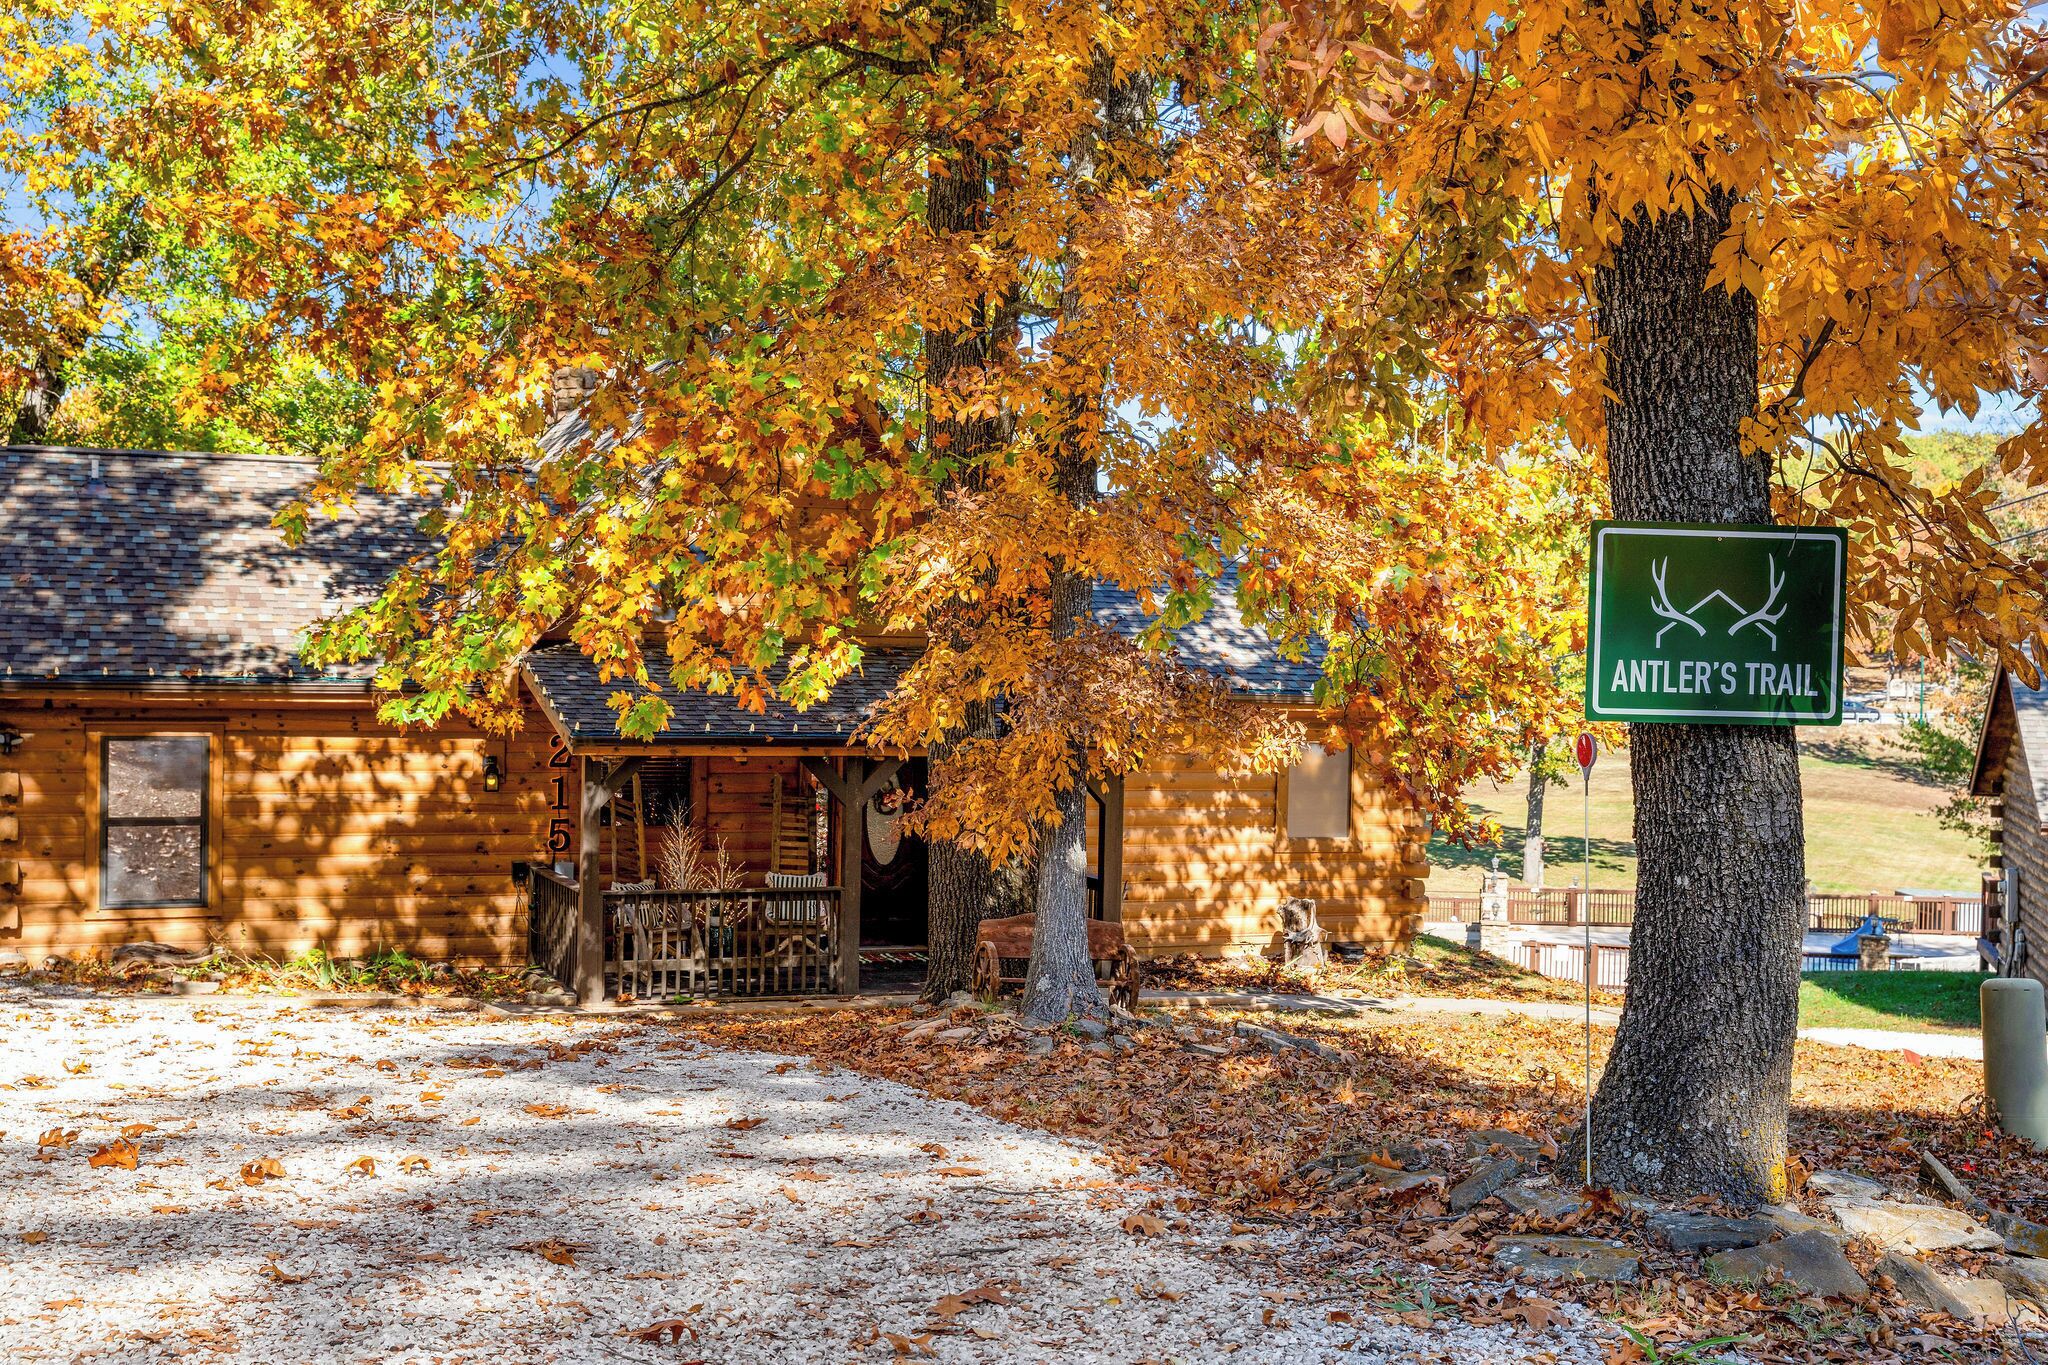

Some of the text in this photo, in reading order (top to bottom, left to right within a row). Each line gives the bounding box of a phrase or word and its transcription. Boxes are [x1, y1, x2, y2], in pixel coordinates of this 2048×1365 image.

[1610, 659, 1818, 697] ANTLER'S TRAIL
[548, 735, 571, 852] 215
